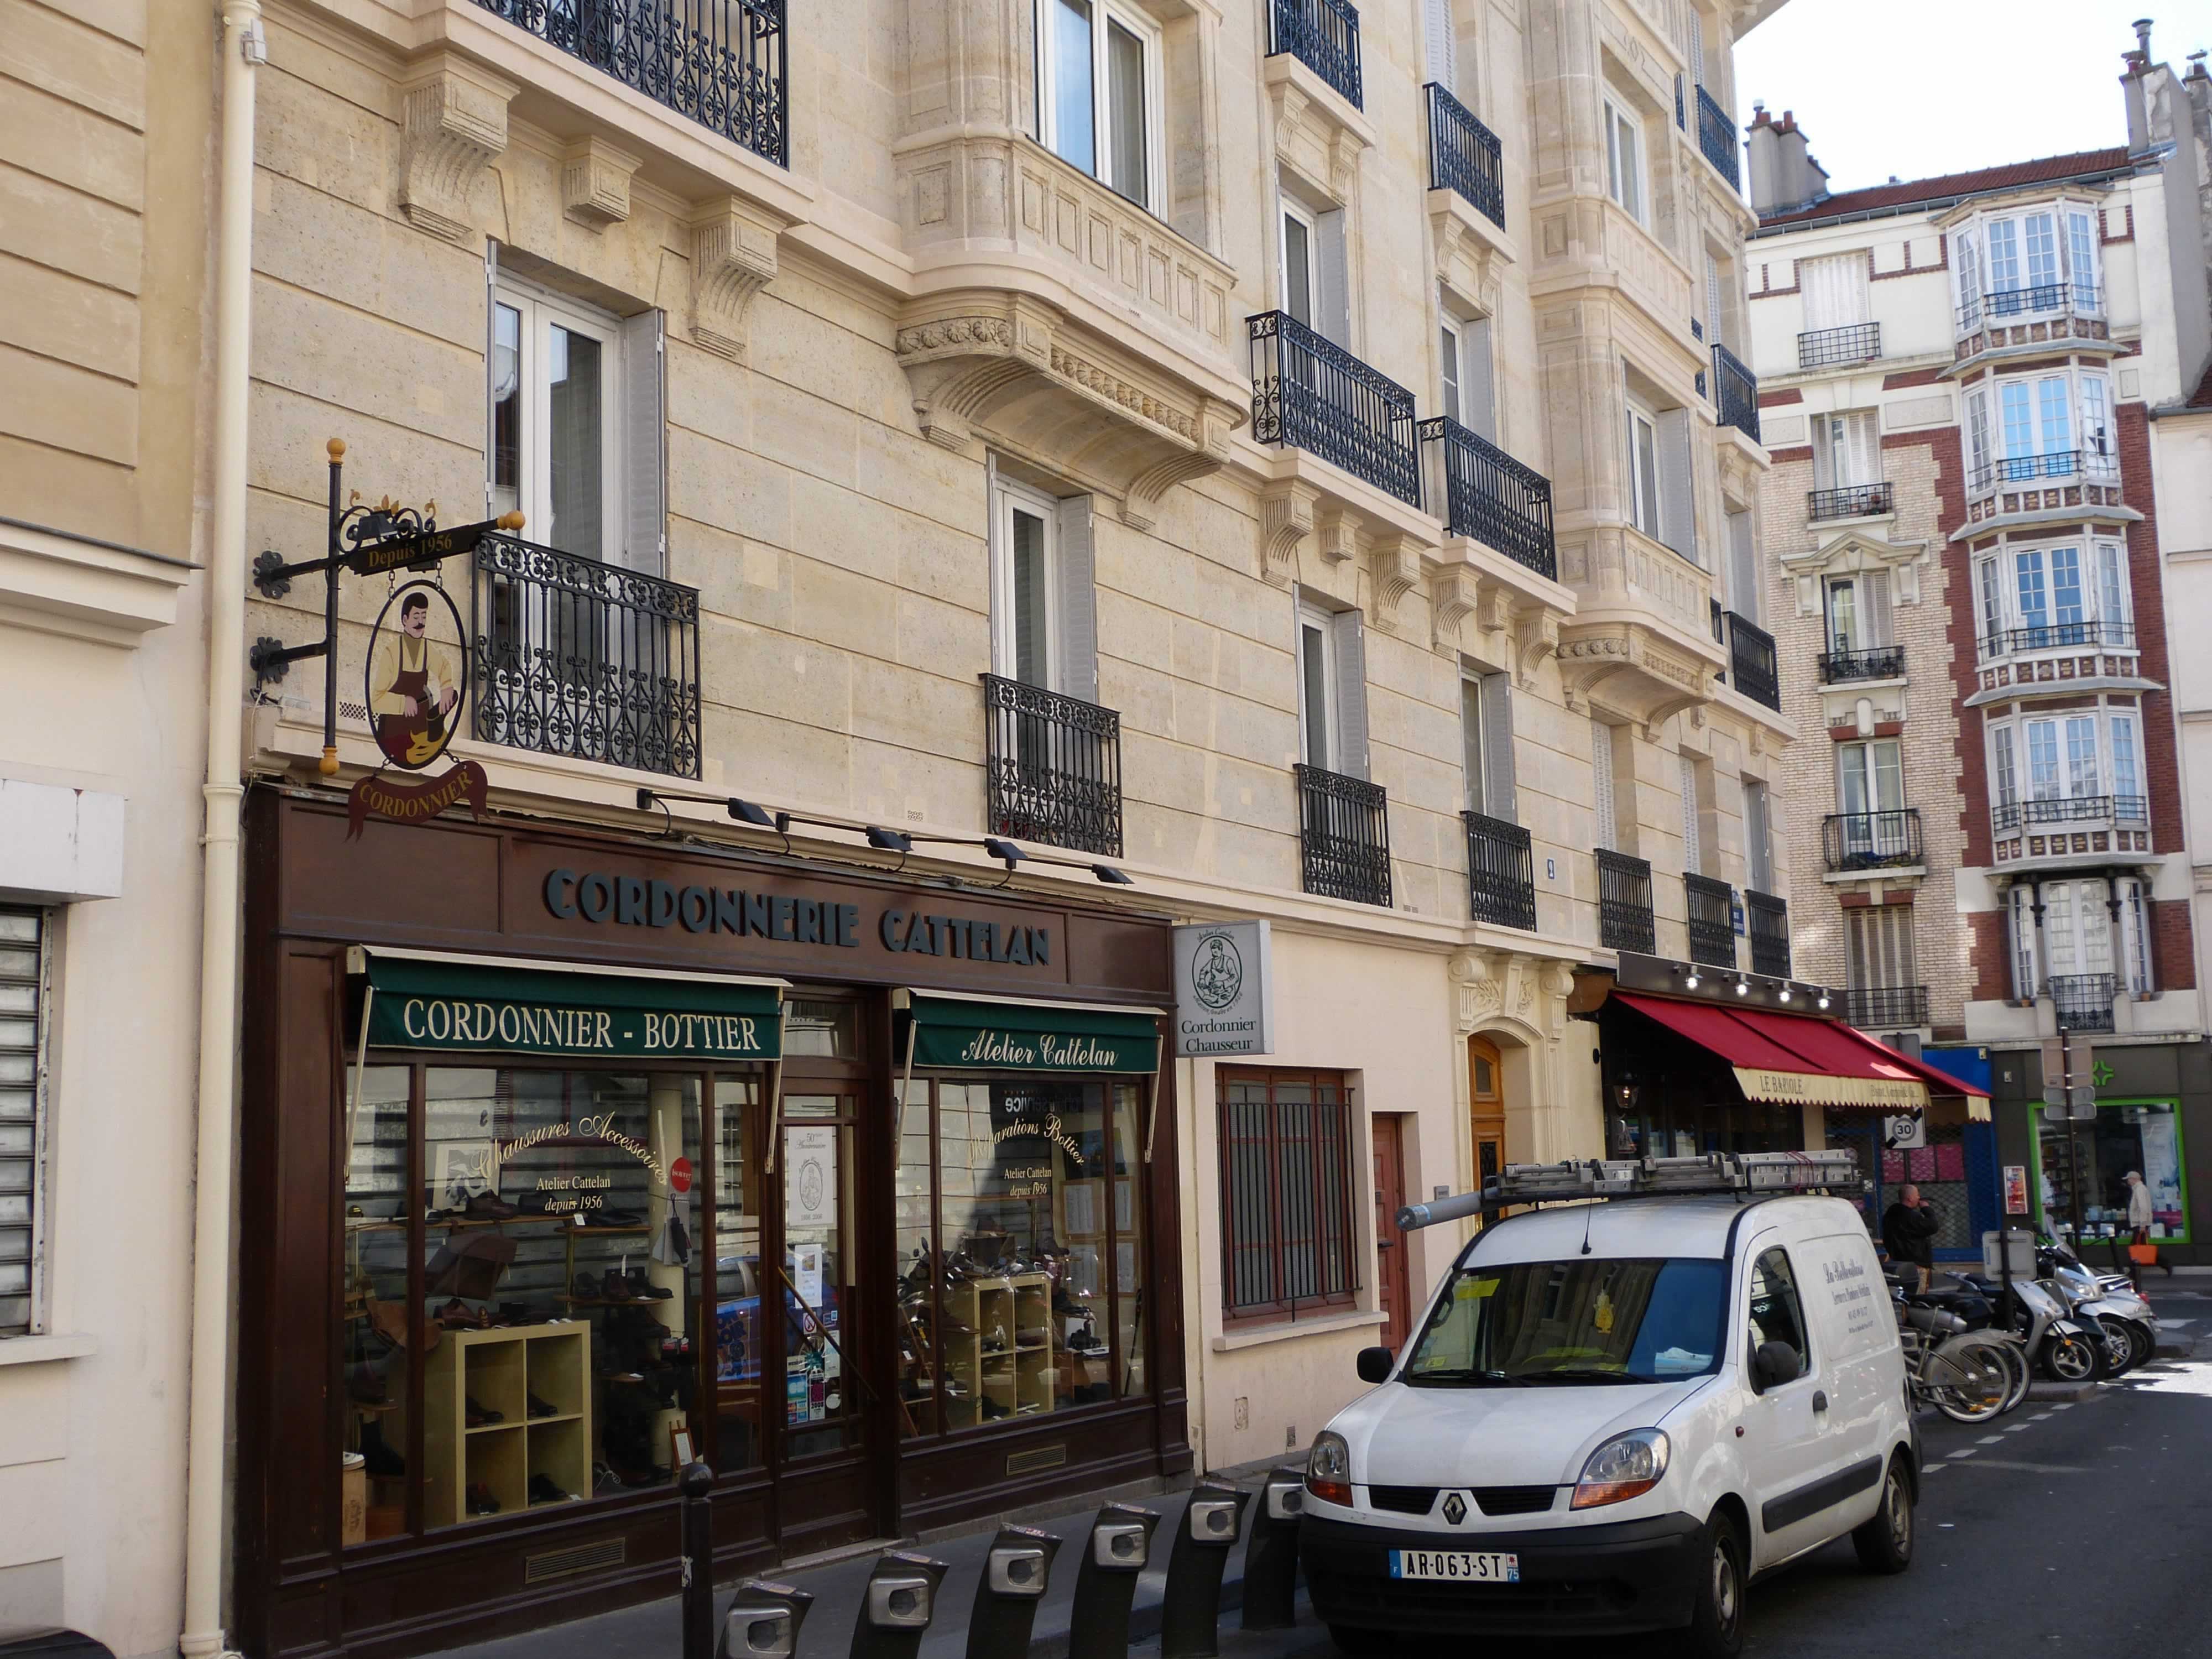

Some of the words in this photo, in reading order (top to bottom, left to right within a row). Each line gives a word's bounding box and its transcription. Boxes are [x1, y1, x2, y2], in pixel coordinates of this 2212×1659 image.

[369, 543, 415, 567] Depuis
[420, 534, 452, 555] 1956
[360, 770, 474, 817] CORDONNIER
[546, 868, 860, 947] CORDONNERIE
[881, 909, 1050, 966] CATTELAN
[404, 999, 613, 1048] CORDONNIER
[644, 1013, 761, 1051] BOTTIER
[1181, 1016, 1256, 1034] Cordonnier
[962, 1029, 1036, 1062] Atelier
[1040, 1034, 1119, 1066] Cattelan
[1186, 1037, 1253, 1053] Chausseur
[1760, 1076, 1771, 1092] LE
[1897, 1125, 1911, 1135] 30
[471, 1121, 570, 1178] Chaussures
[578, 1111, 667, 1186] Accessoires
[1044, 1113, 1084, 1166] Bottier
[1004, 1168, 1025, 1180] Atelier
[1027, 1167, 1052, 1178] Cattelan
[536, 1177, 570, 1191] Atelier
[572, 1175, 611, 1189] Cattelan
[1010, 1185, 1031, 1198] depuis
[1032, 1182, 1047, 1195] 1956
[545, 1197, 577, 1214] depuis
[580, 1196, 603, 1210] 1956
[1407, 1552, 1500, 1578] AR-063-ST
[1508, 1568, 1519, 1580] 75
